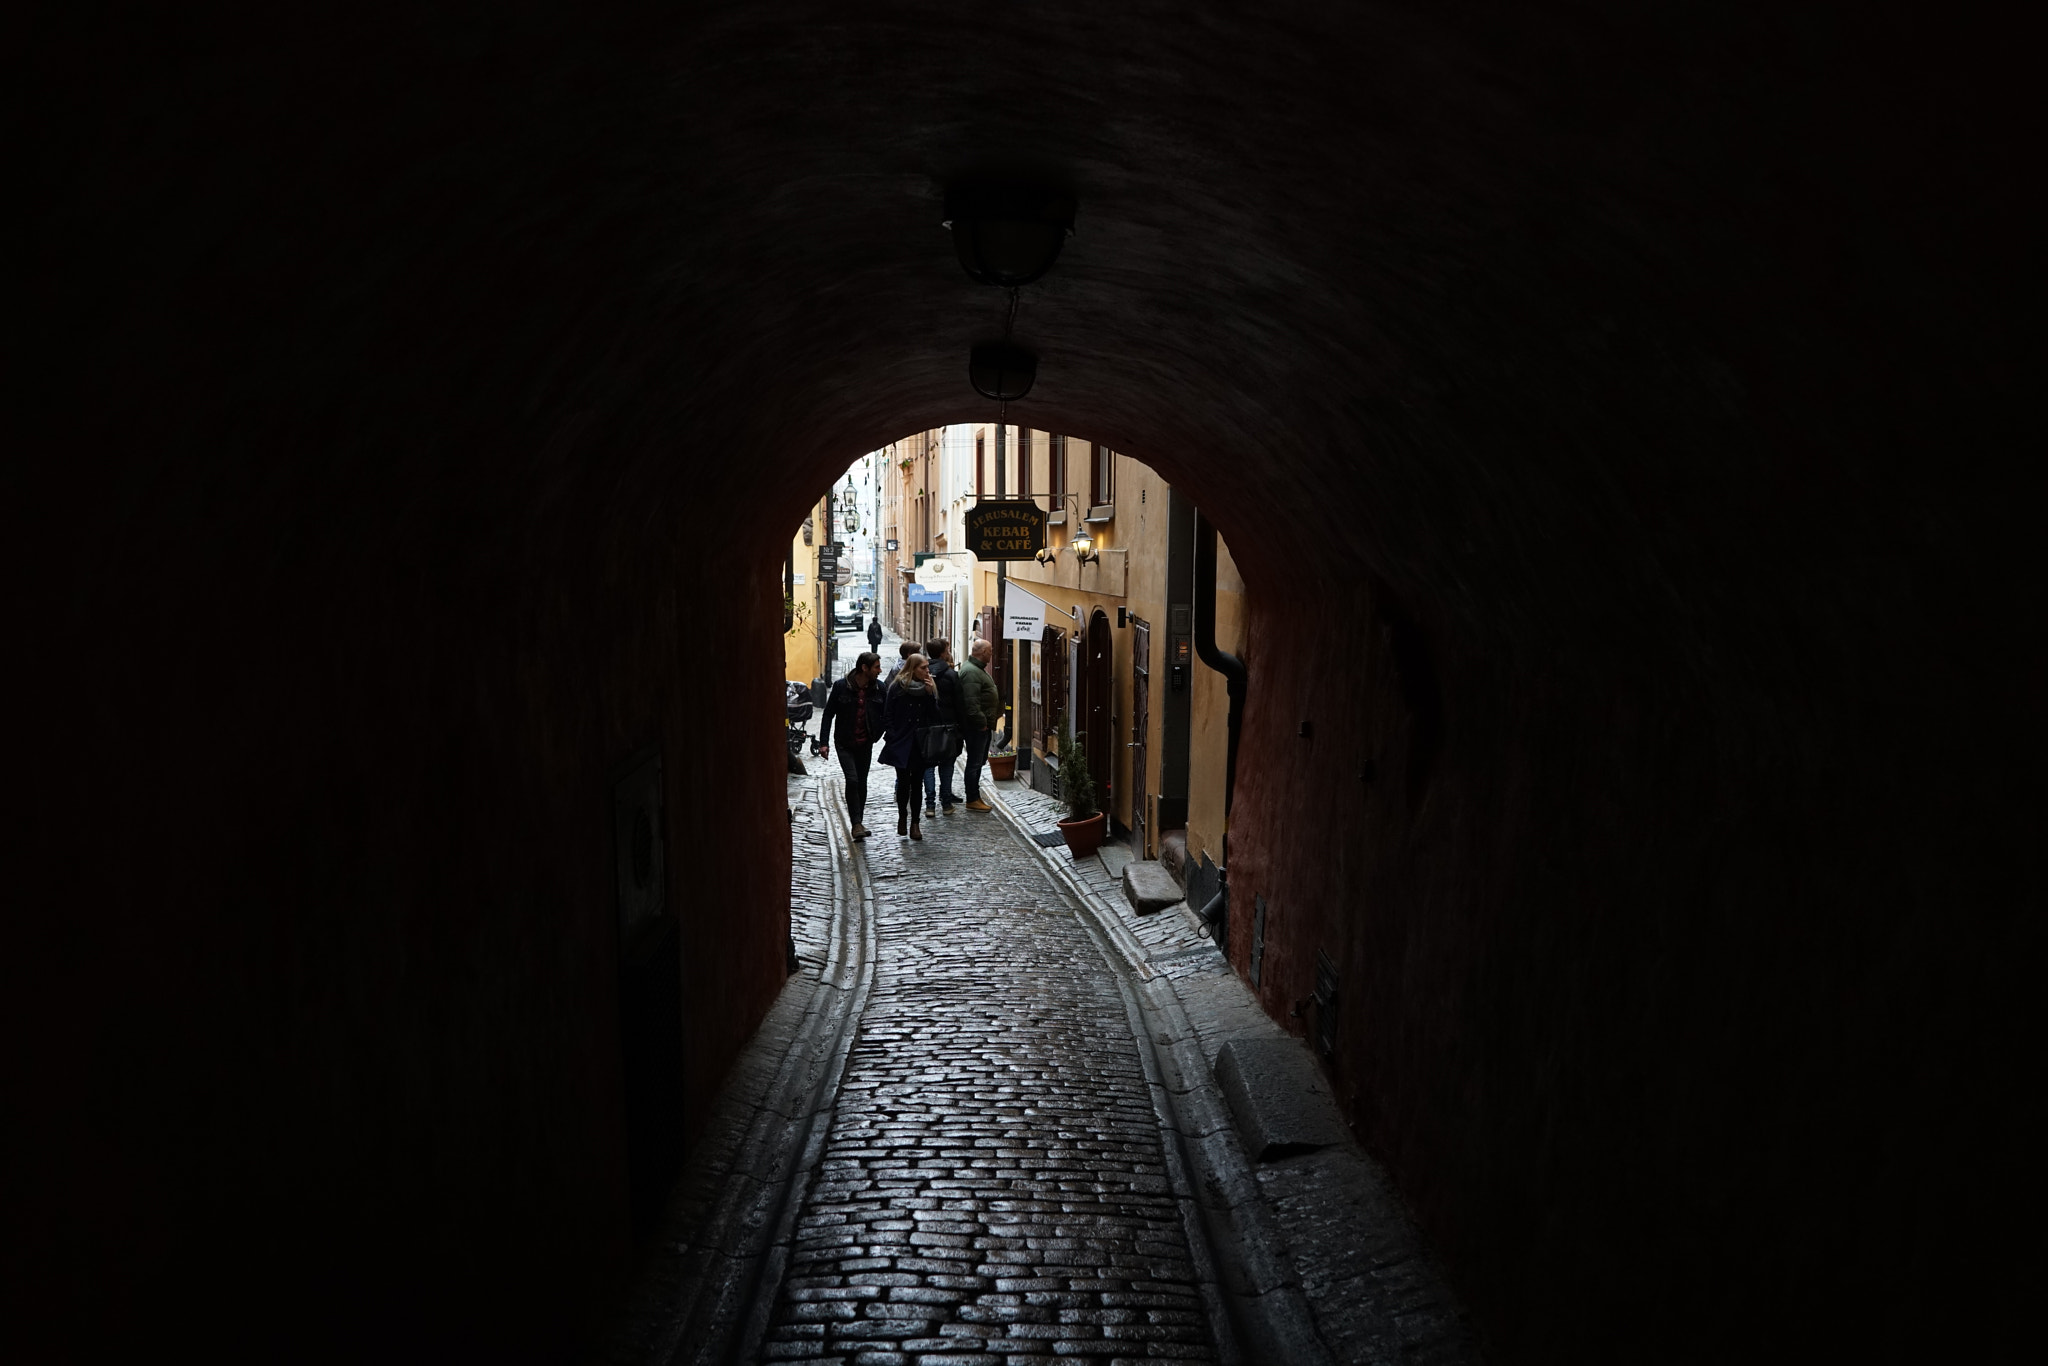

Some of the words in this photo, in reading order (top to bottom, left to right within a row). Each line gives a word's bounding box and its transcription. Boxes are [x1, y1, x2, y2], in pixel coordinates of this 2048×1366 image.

[972, 510, 1039, 529] JERUSALEM
[983, 526, 1030, 537] KEBAB
[980, 540, 993, 551] &
[996, 536, 1032, 550] CAFÉ
